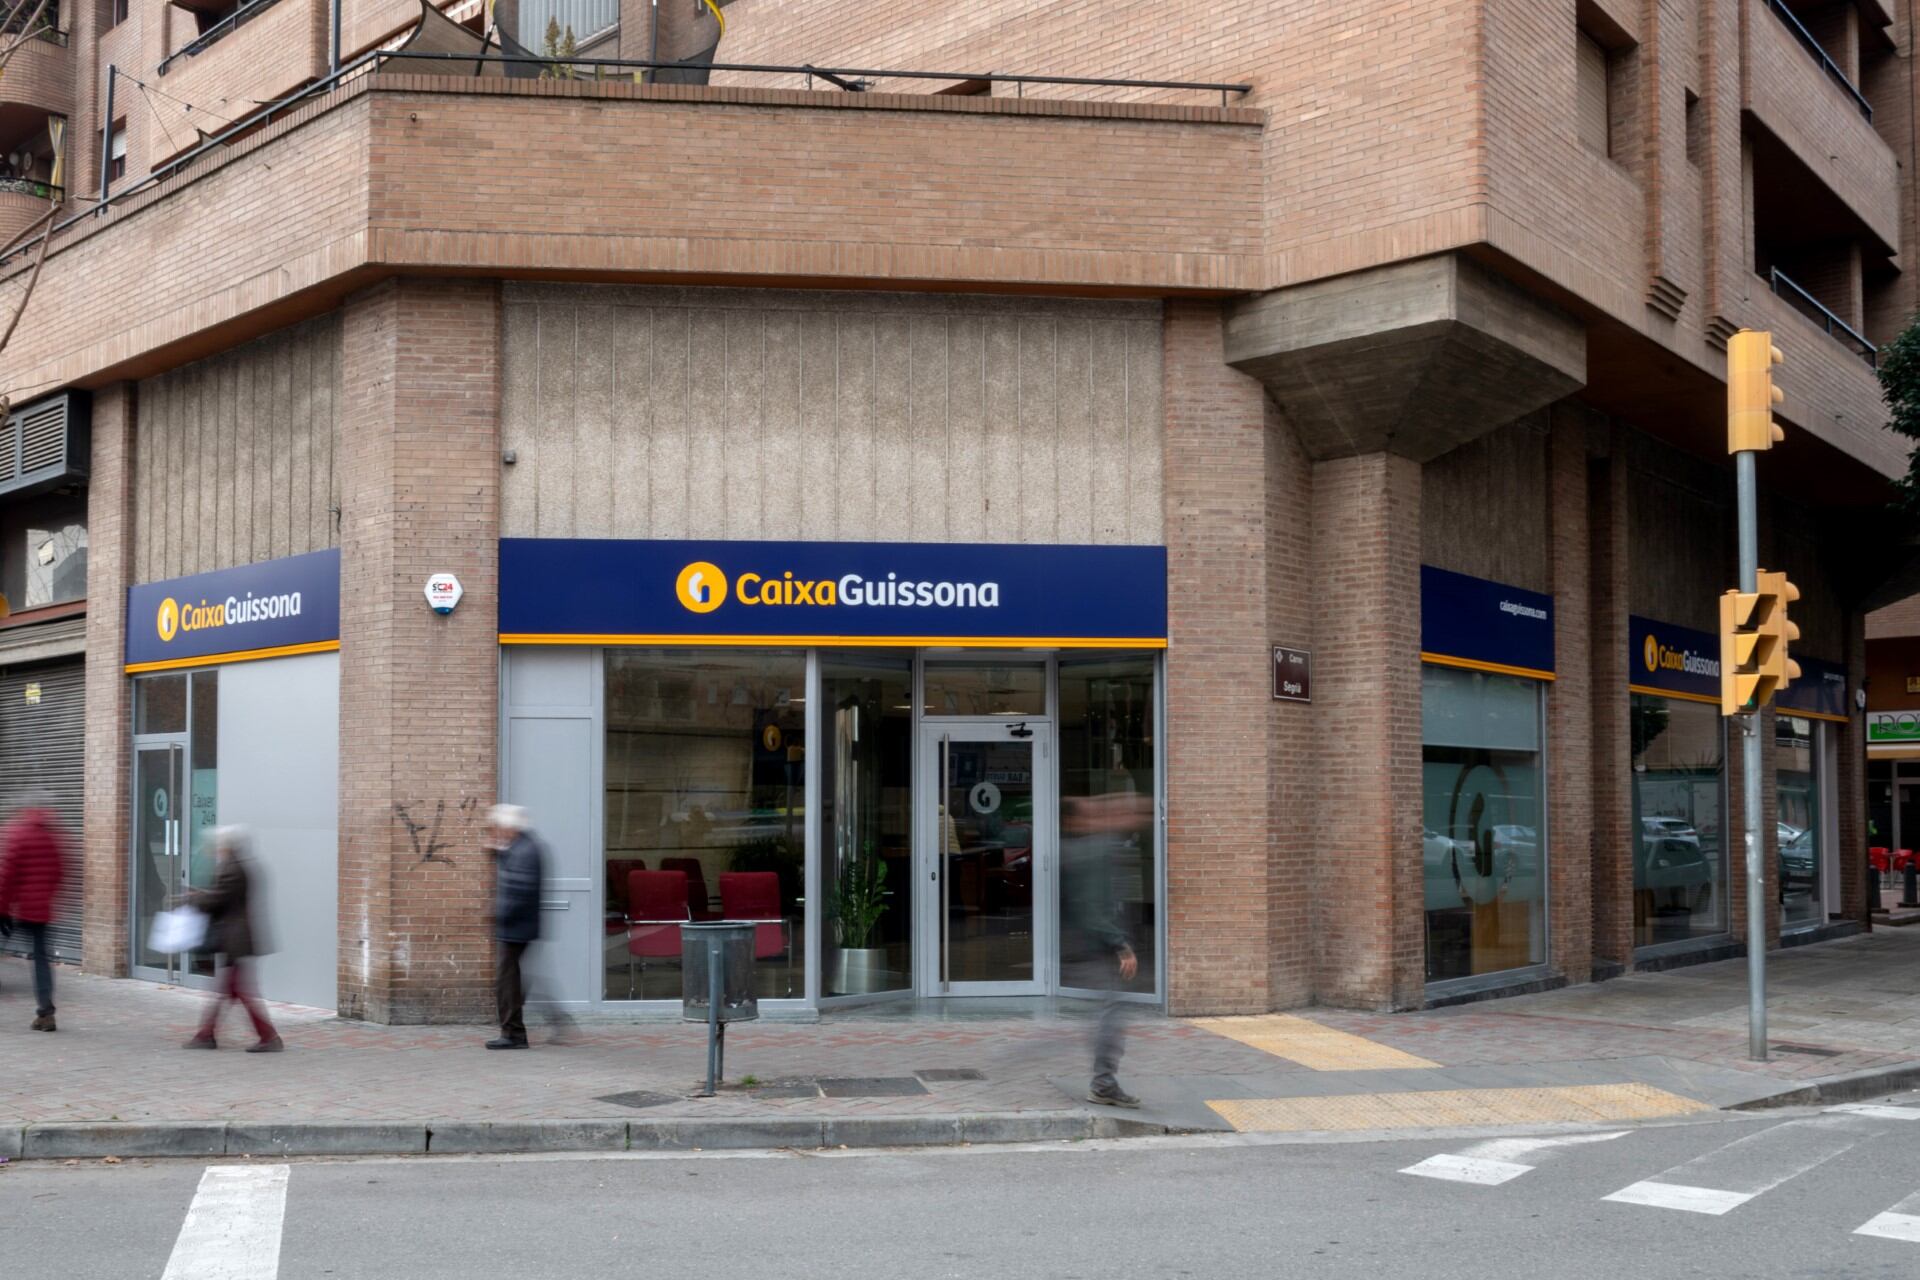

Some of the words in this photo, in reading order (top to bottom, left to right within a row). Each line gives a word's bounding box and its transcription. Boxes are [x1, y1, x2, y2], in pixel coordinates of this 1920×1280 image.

[736, 571, 999, 607] CaixaGuissona
[181, 592, 302, 631] CaixaGuissona
[1659, 645, 1720, 677] CaixaGuissona
